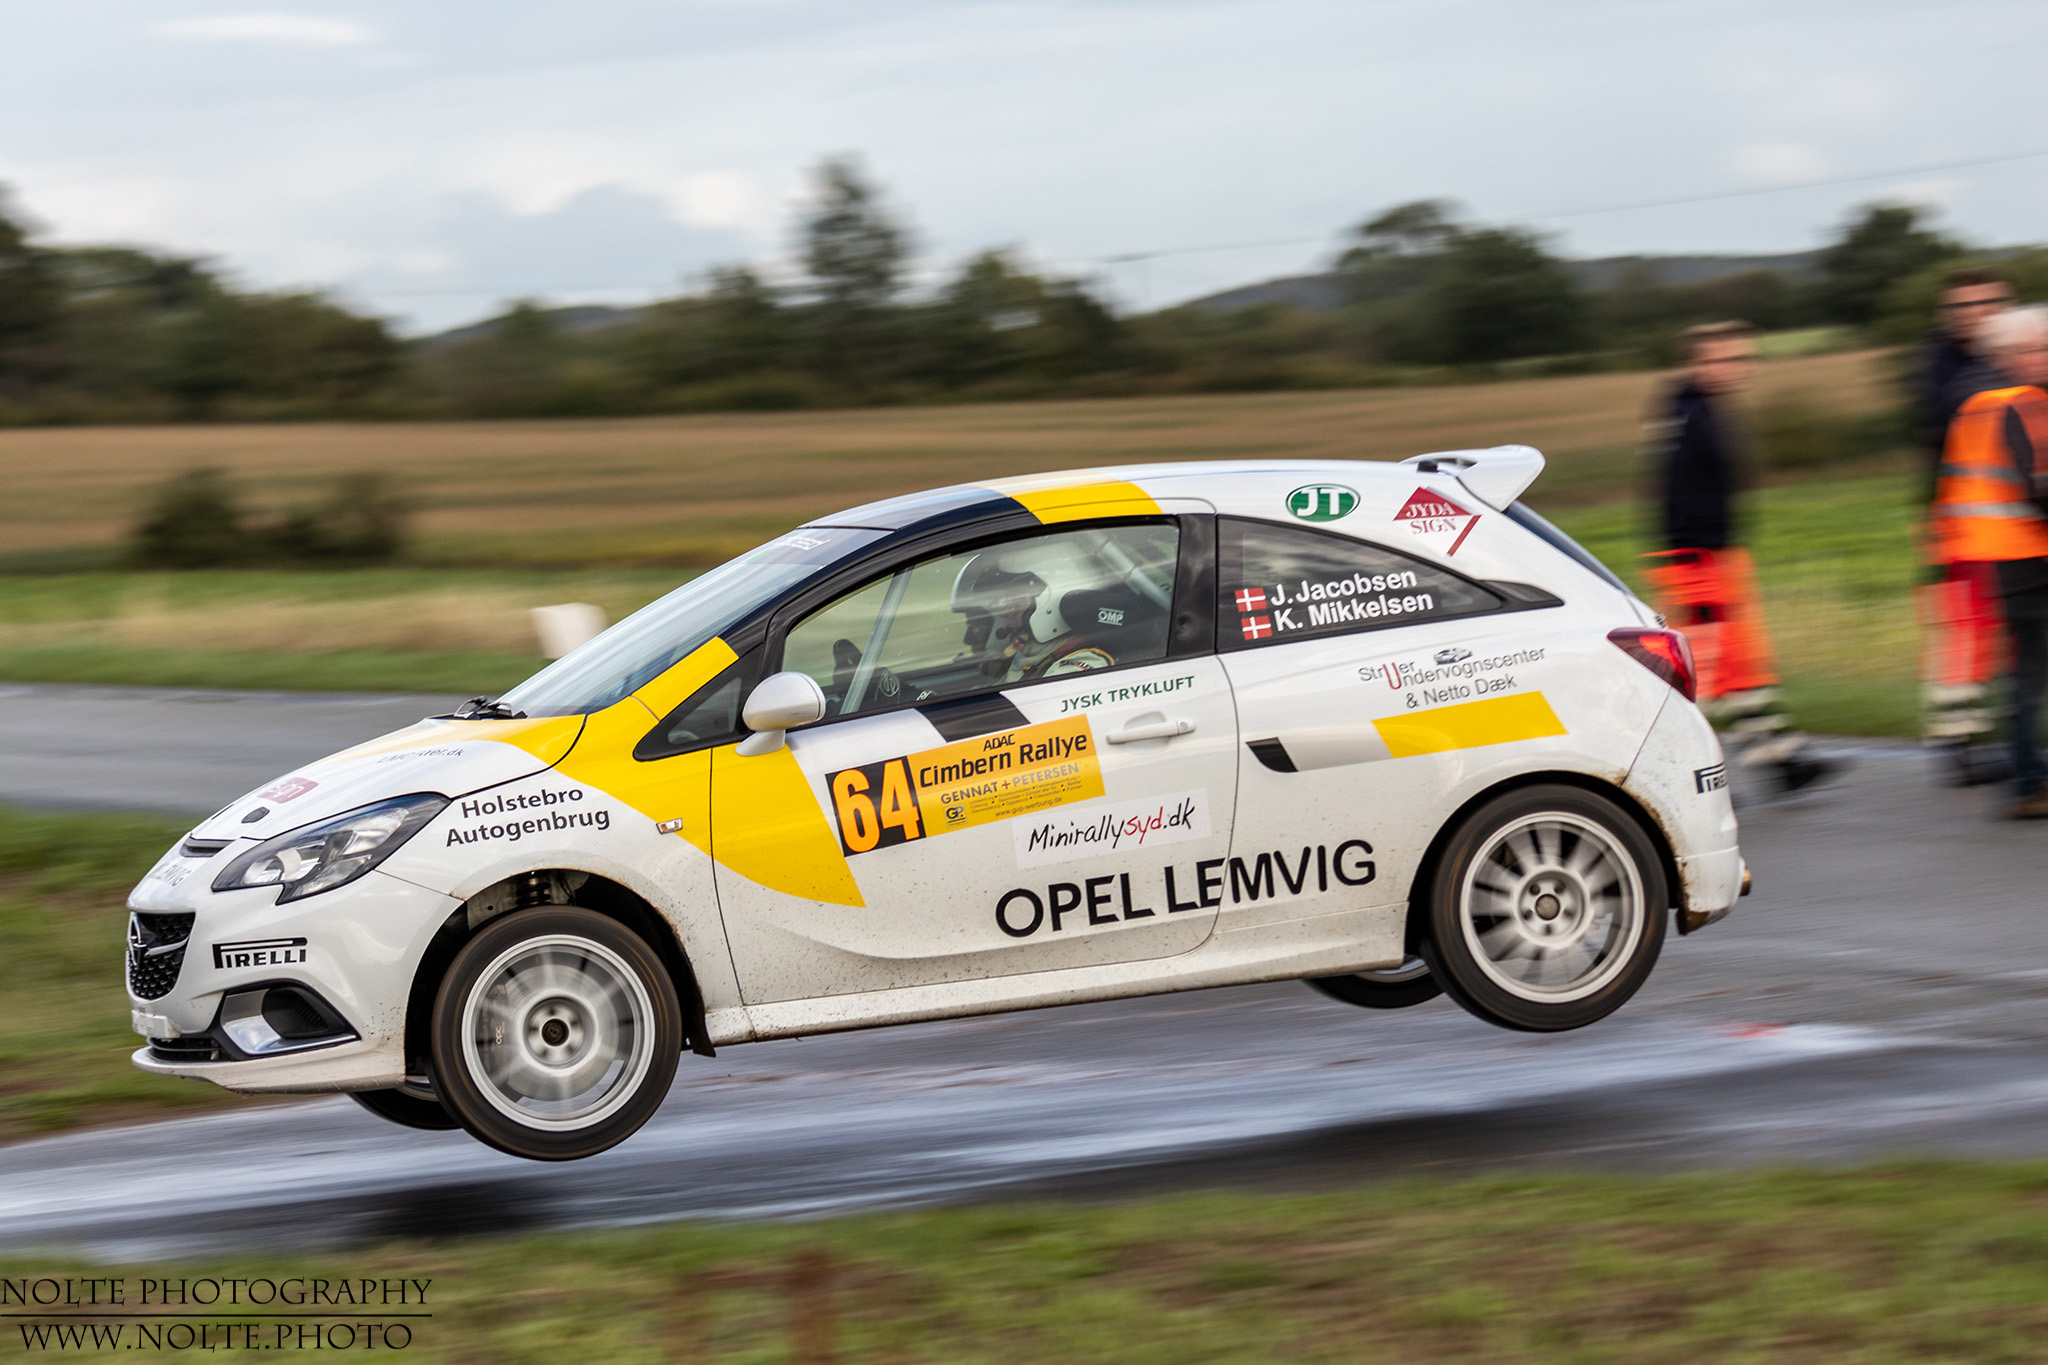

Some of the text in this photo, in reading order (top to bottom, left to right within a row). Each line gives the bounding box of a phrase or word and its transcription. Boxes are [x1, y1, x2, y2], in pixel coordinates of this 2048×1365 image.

[1297, 488, 1349, 517] JT
[1405, 502, 1456, 518] JYDA
[1410, 518, 1457, 534] SIGN
[1098, 609, 1124, 624] OMP
[1274, 593, 1434, 631] K. Mikkelsen
[1383, 648, 1546, 690] Undervognscenter
[1061, 675, 1195, 712] JYSK TRYKLUFT
[1405, 673, 1518, 709] & Netto Dæk
[919, 733, 1088, 788] Cimbern Rallye
[984, 733, 1016, 752] ADAC
[940, 781, 998, 804] GENNAT
[1012, 762, 1080, 788] PETERSEN
[461, 789, 583, 818] Holstebro
[833, 760, 921, 853] 64
[446, 810, 611, 848] Autogenbrug
[1028, 798, 1196, 852] Minirallysyd.dk
[995, 839, 1376, 938] OPEL LEMVIG
[212, 937, 308, 969] PIRELLI
